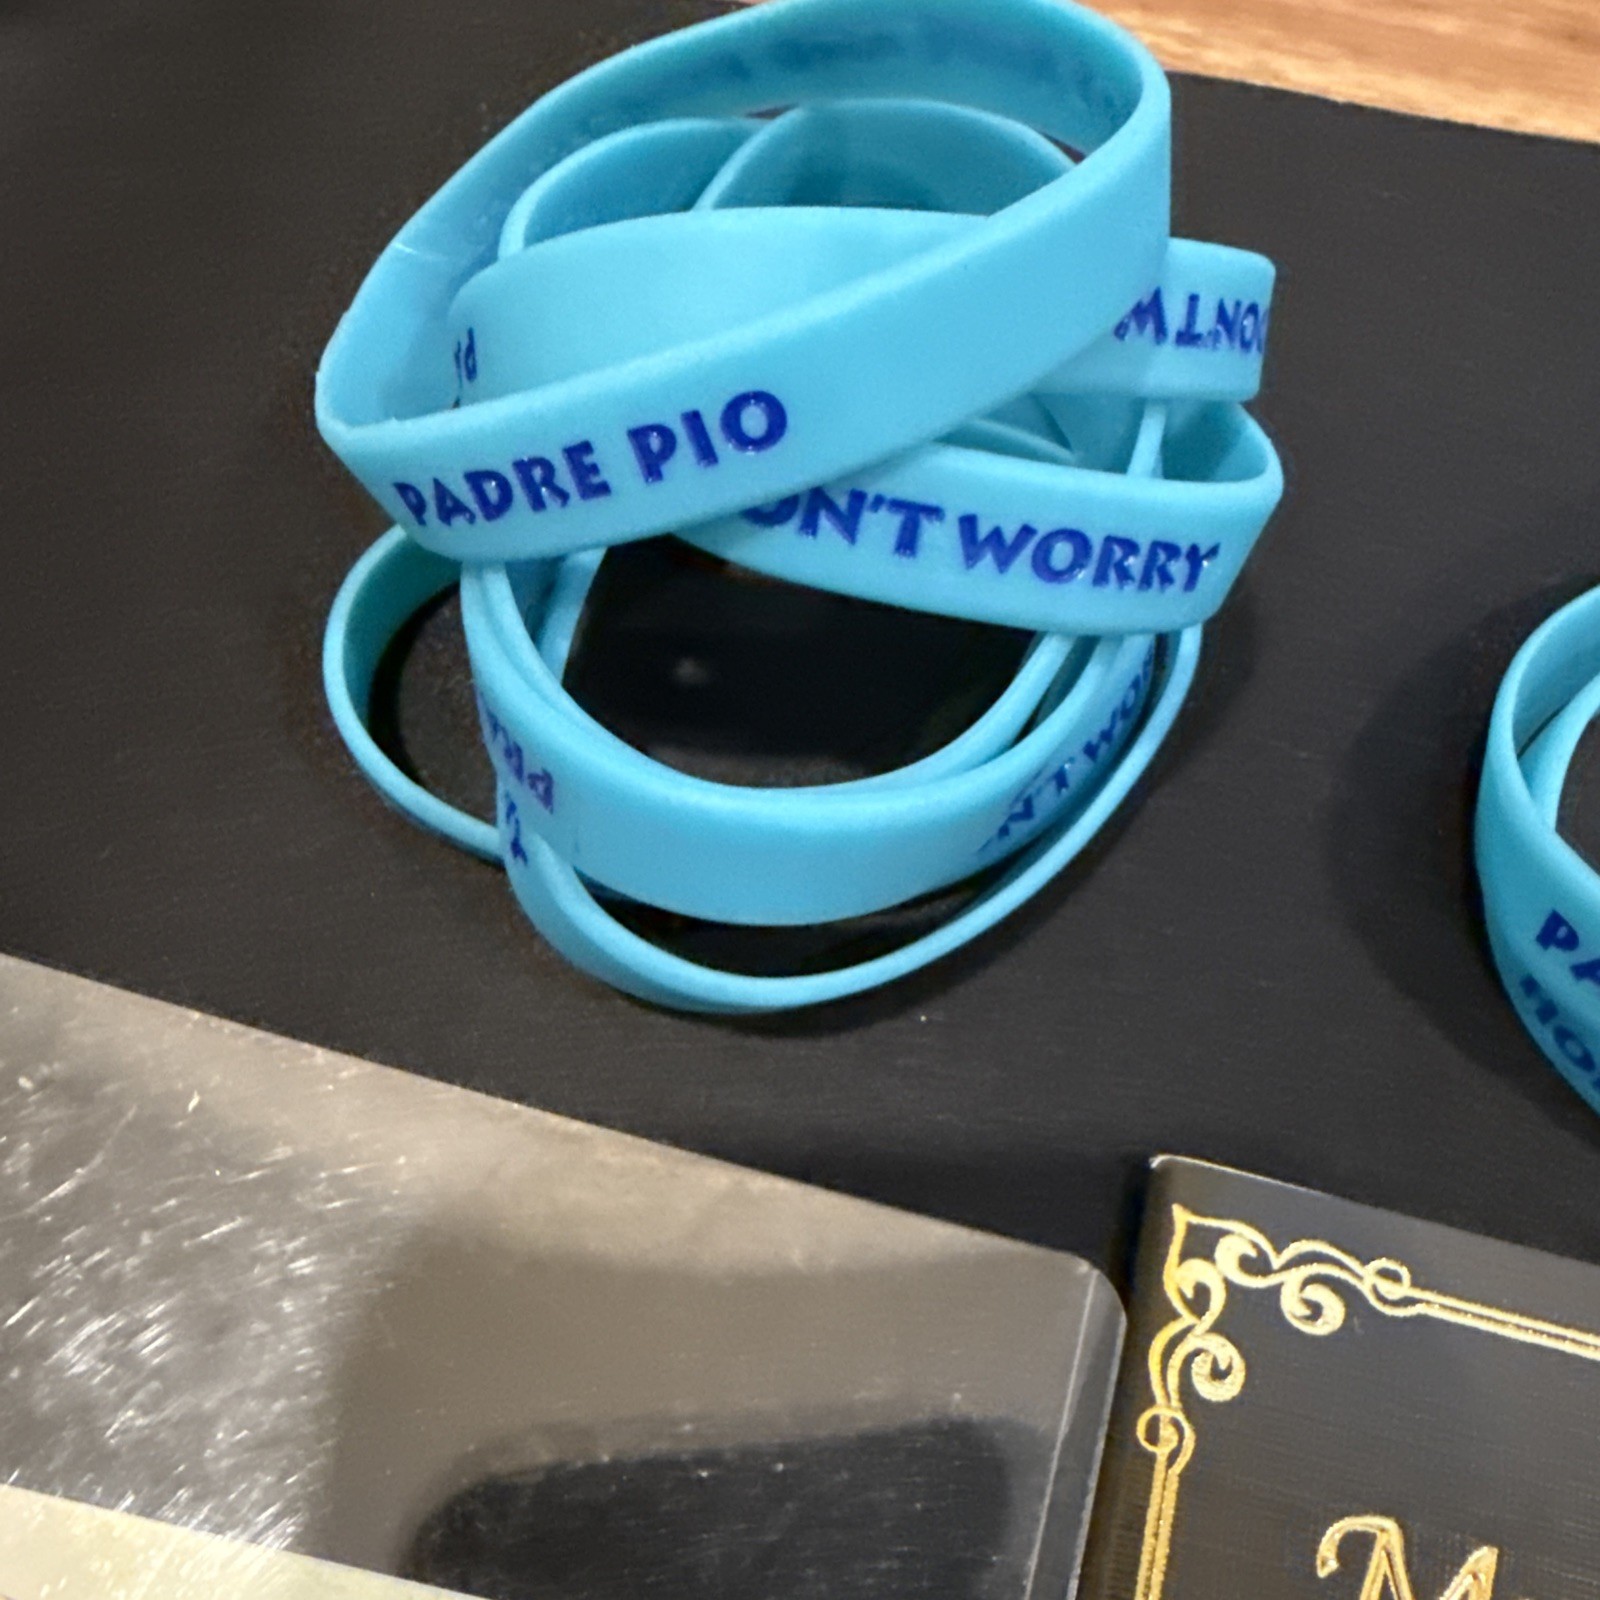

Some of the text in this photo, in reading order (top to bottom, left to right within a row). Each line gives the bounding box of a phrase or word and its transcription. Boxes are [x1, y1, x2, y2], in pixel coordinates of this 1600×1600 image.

[1174, 293, 1271, 353] ON'T
[393, 390, 788, 528] PADRE PIO
[740, 485, 1221, 594] N'T WORRY
